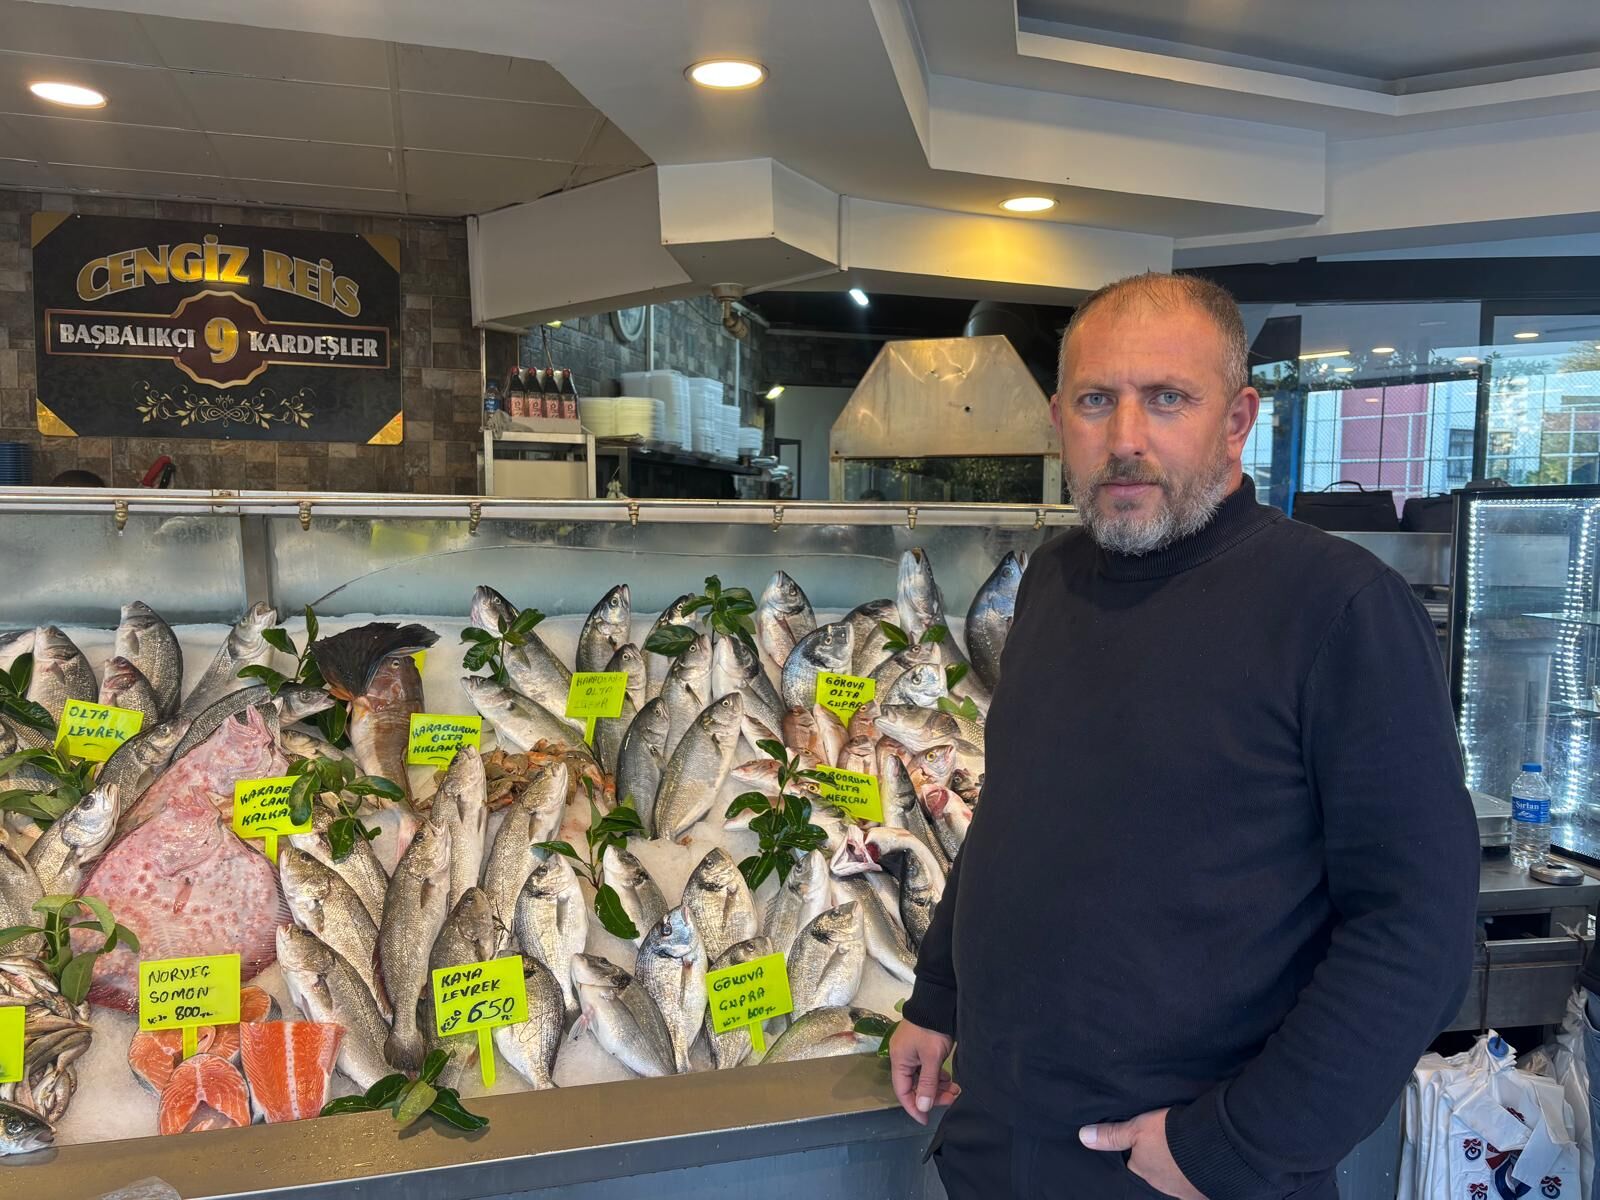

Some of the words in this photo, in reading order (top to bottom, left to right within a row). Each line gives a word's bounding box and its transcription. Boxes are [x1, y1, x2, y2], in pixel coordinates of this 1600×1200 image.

[77, 234, 250, 301] CENGİZ
[59, 323, 196, 352] BAŞBALIKÇI
[204, 317, 239, 364] 9
[248, 331, 378, 360] KARDEŞLER
[830, 689, 860, 699] OLTA
[69, 706, 109, 720] OLTA
[68, 725, 126, 741] LEVREK
[431, 734, 463, 743] OLTA
[240, 785, 292, 805] KARADE
[840, 784, 860, 794] LTA
[260, 796, 290, 807] CAN
[826, 793, 868, 805] MERCAN
[241, 808, 291, 826] KALKA
[148, 965, 211, 987] NORVEG
[441, 968, 483, 988] KAYA
[149, 987, 209, 1004] SOMON
[442, 979, 501, 1003] LEVREK
[174, 1005, 201, 1021] 800
[467, 997, 515, 1023] 650
[747, 1006, 764, 1019] 600
